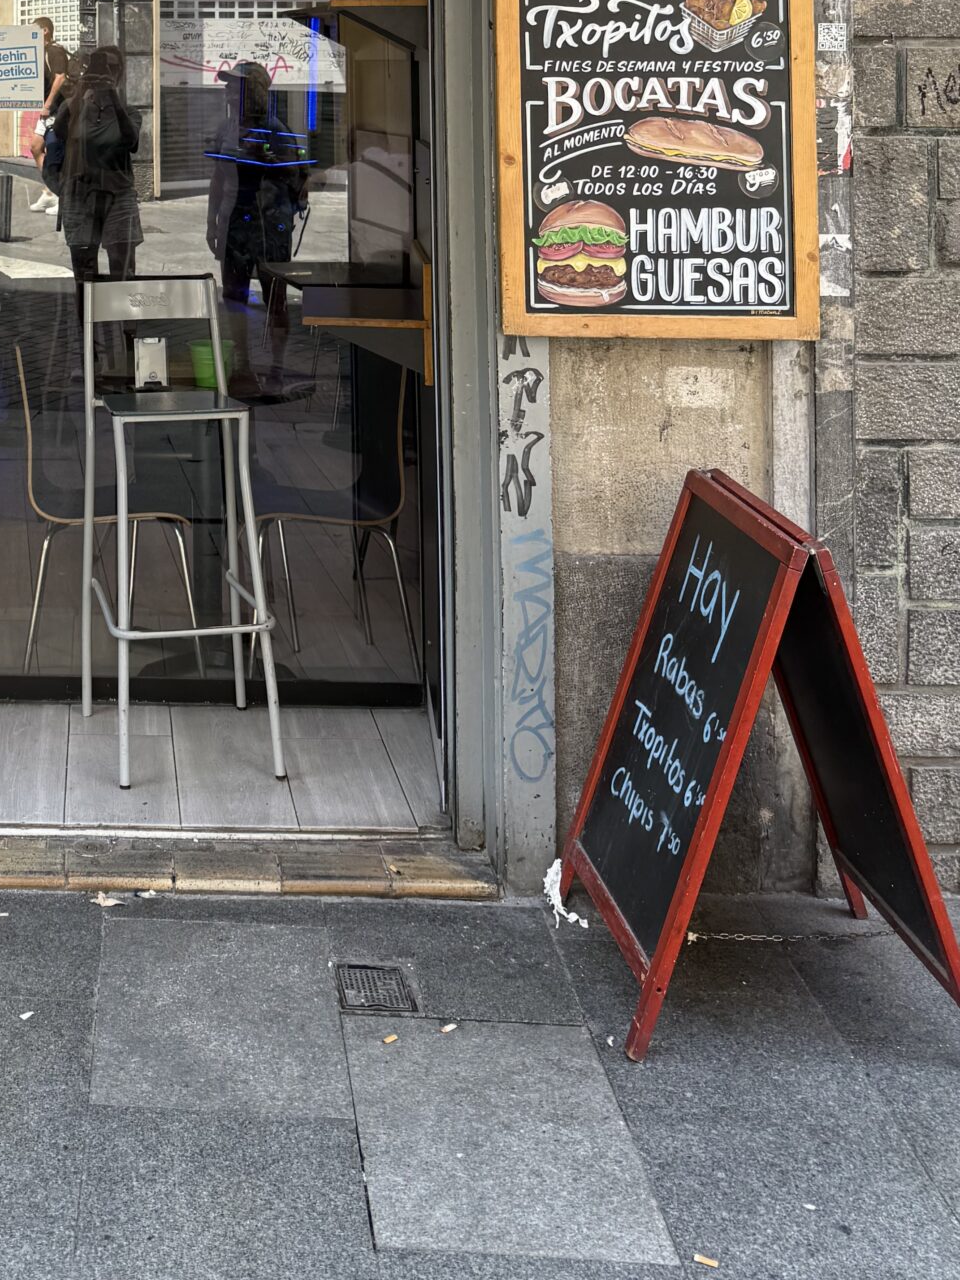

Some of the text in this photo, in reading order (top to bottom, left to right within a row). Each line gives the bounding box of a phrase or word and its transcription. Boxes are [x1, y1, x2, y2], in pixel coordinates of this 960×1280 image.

[543, 59, 765, 72] FINES DE SEMANA Y FESTIVOS
[542, 77, 771, 135] BOCATAS
[543, 125, 625, 162] AL MOMENTO
[573, 179, 626, 195] TODOS
[632, 183, 663, 195] LOS
[671, 179, 717, 195] DÍAS
[592, 166, 611, 178] DE
[618, 165, 659, 178] 12:00
[676, 167, 718, 179] 16:30
[629, 207, 783, 253] HAMBUR
[630, 256, 785, 304] GUESAS
[679, 533, 740, 664] Hay
[654, 633, 705, 719] Rabas
[633, 699, 686, 793] Txopitos
[611, 767, 654, 831] Chipis
